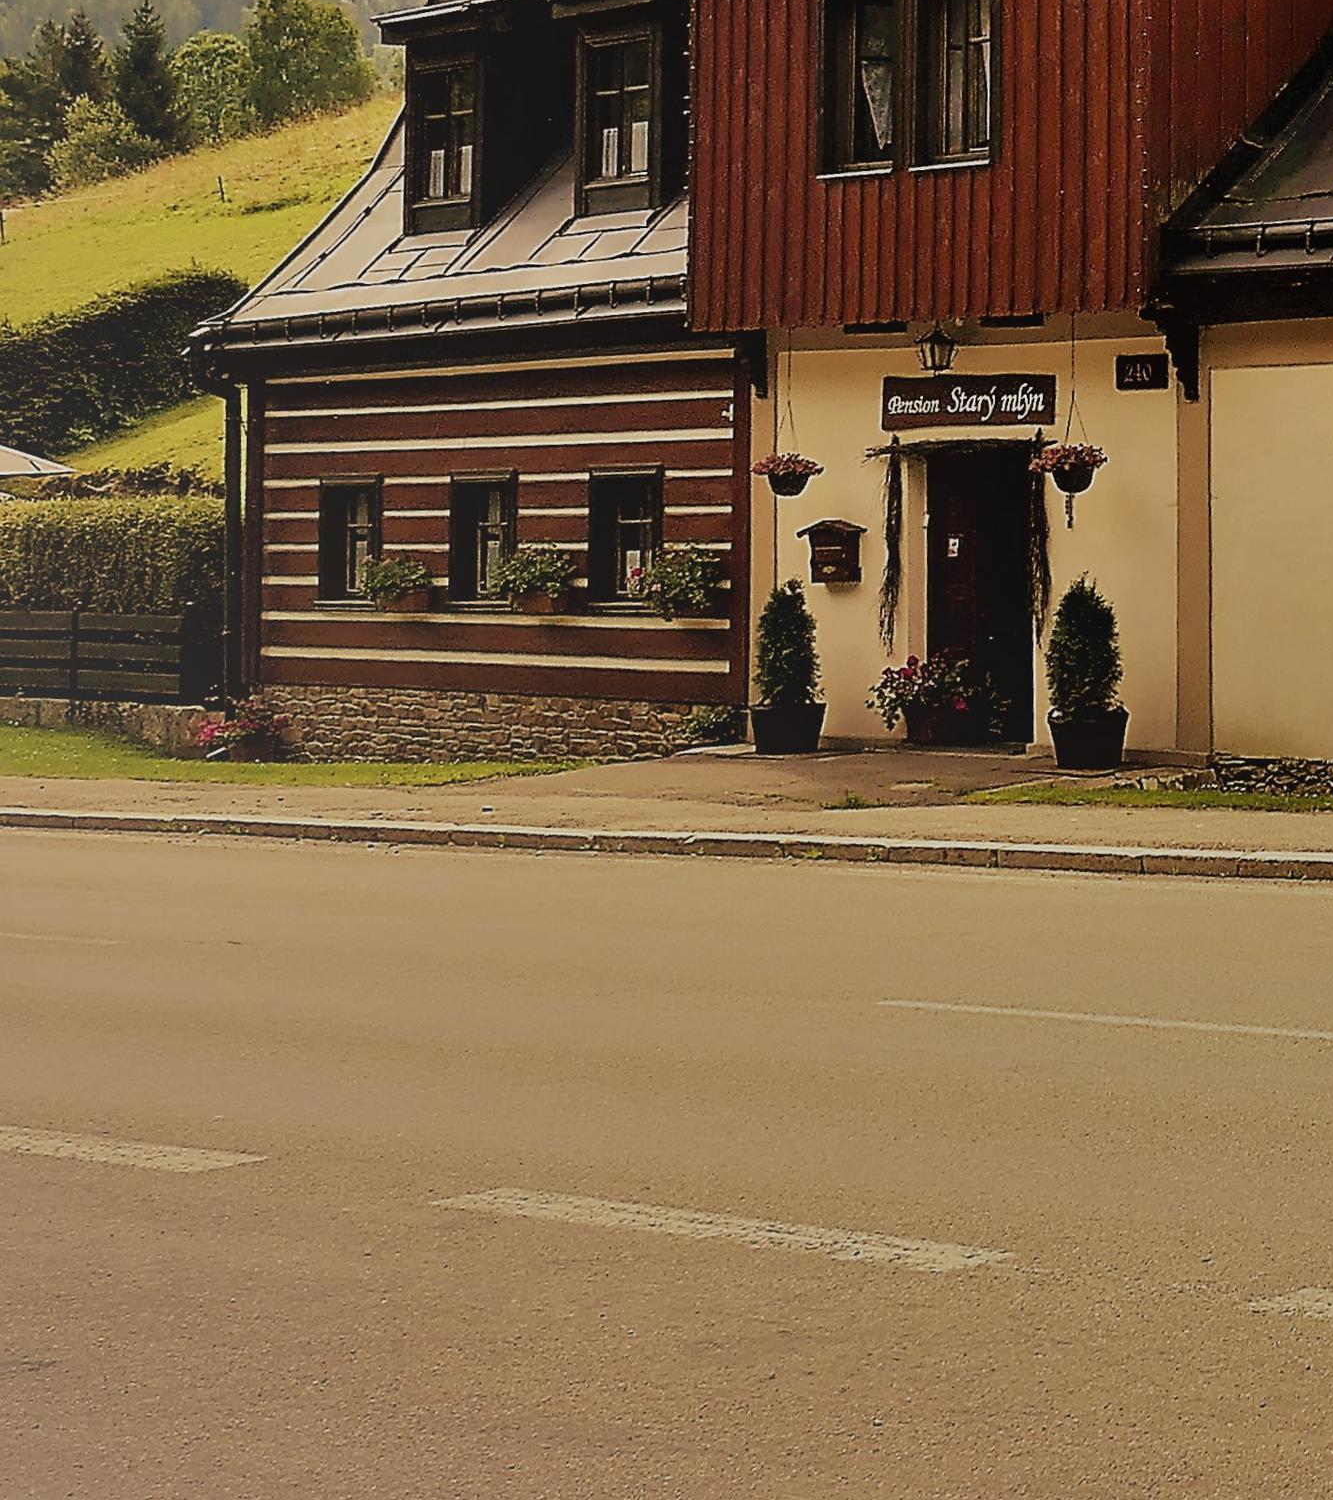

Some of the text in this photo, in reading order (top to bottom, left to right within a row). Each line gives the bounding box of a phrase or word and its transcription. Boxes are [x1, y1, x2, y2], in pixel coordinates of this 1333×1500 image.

[1124, 363, 1152, 382] 240
[888, 383, 1045, 421] Pension Starý mlýn
